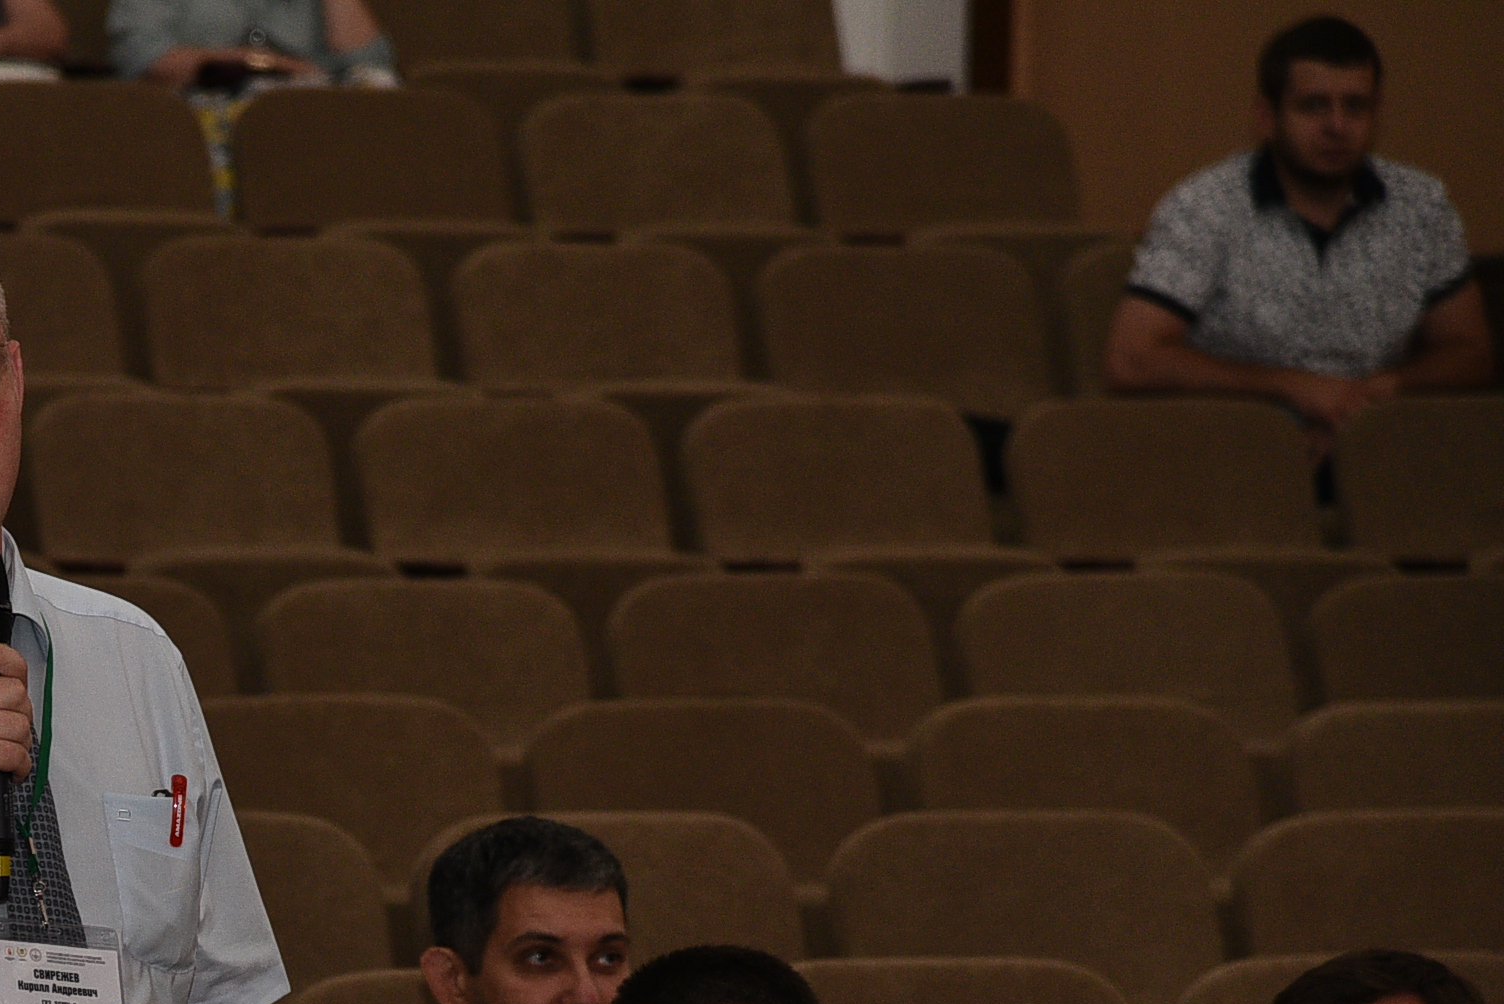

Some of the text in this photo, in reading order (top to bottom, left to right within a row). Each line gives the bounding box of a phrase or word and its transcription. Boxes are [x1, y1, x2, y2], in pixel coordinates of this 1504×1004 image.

[33, 968, 80, 983] СВИРЕЖЕВ
[18, 980, 98, 997] Кирилл Андреевич
